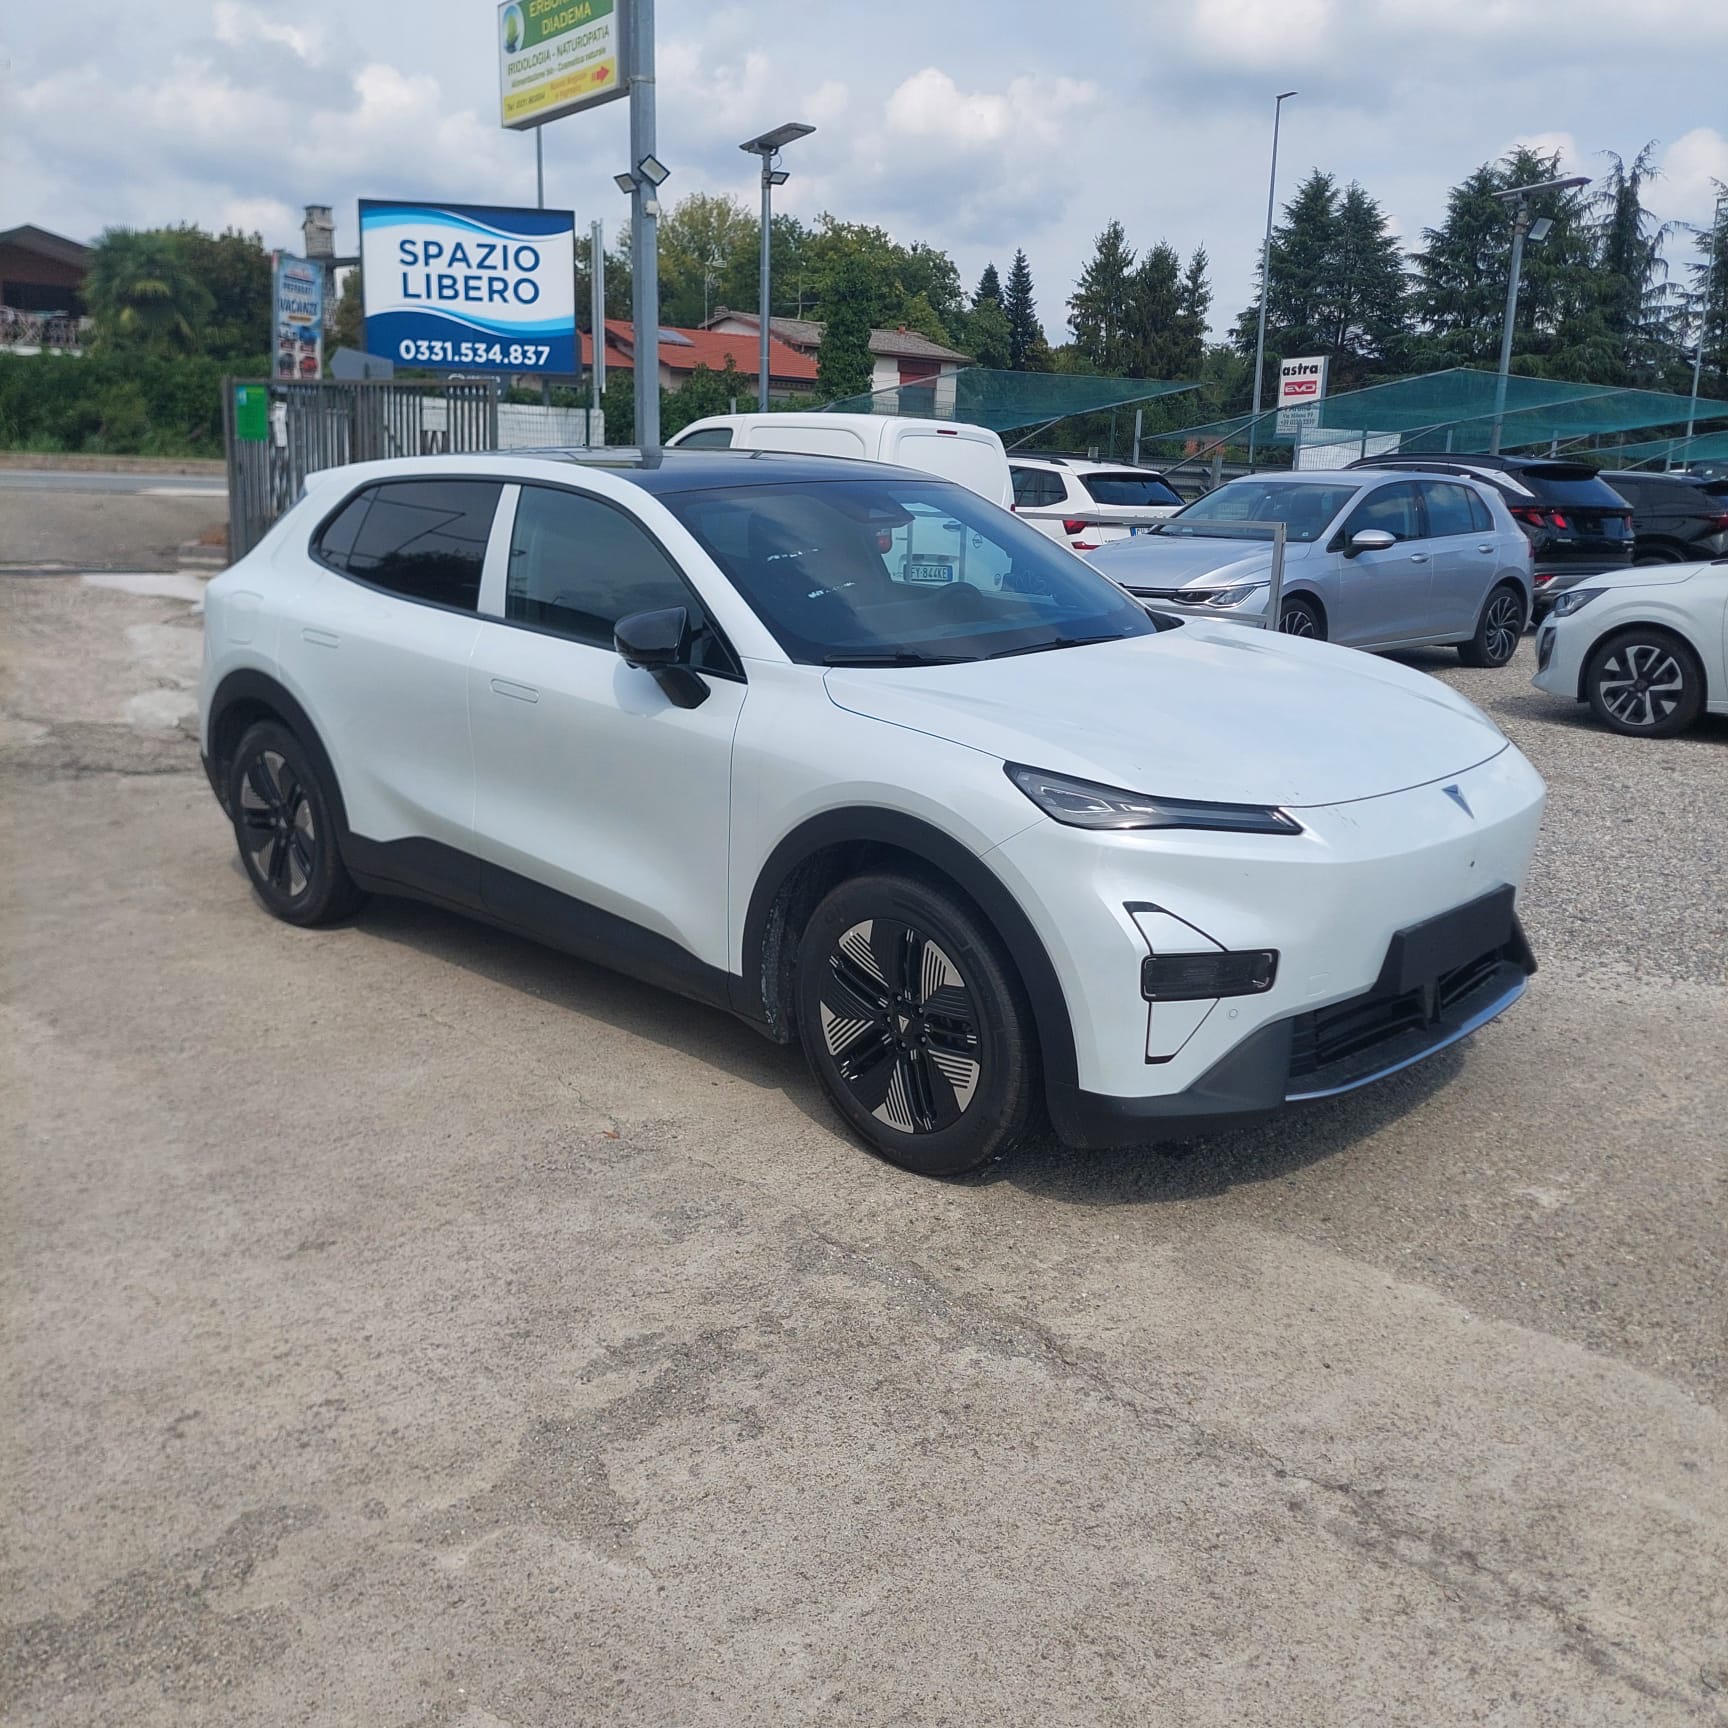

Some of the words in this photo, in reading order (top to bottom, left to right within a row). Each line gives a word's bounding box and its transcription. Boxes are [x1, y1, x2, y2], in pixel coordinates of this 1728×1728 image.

[541, 1, 592, 35] DIADEMA
[556, 24, 610, 56] NATUROPATIA
[399, 239, 540, 273] SPAZIO
[402, 272, 540, 305] LIBERO
[280, 298, 318, 316] VACANZE
[399, 339, 550, 366] 0331.534.837
[1282, 363, 1318, 376] astra
[1285, 384, 1316, 393] EVO
